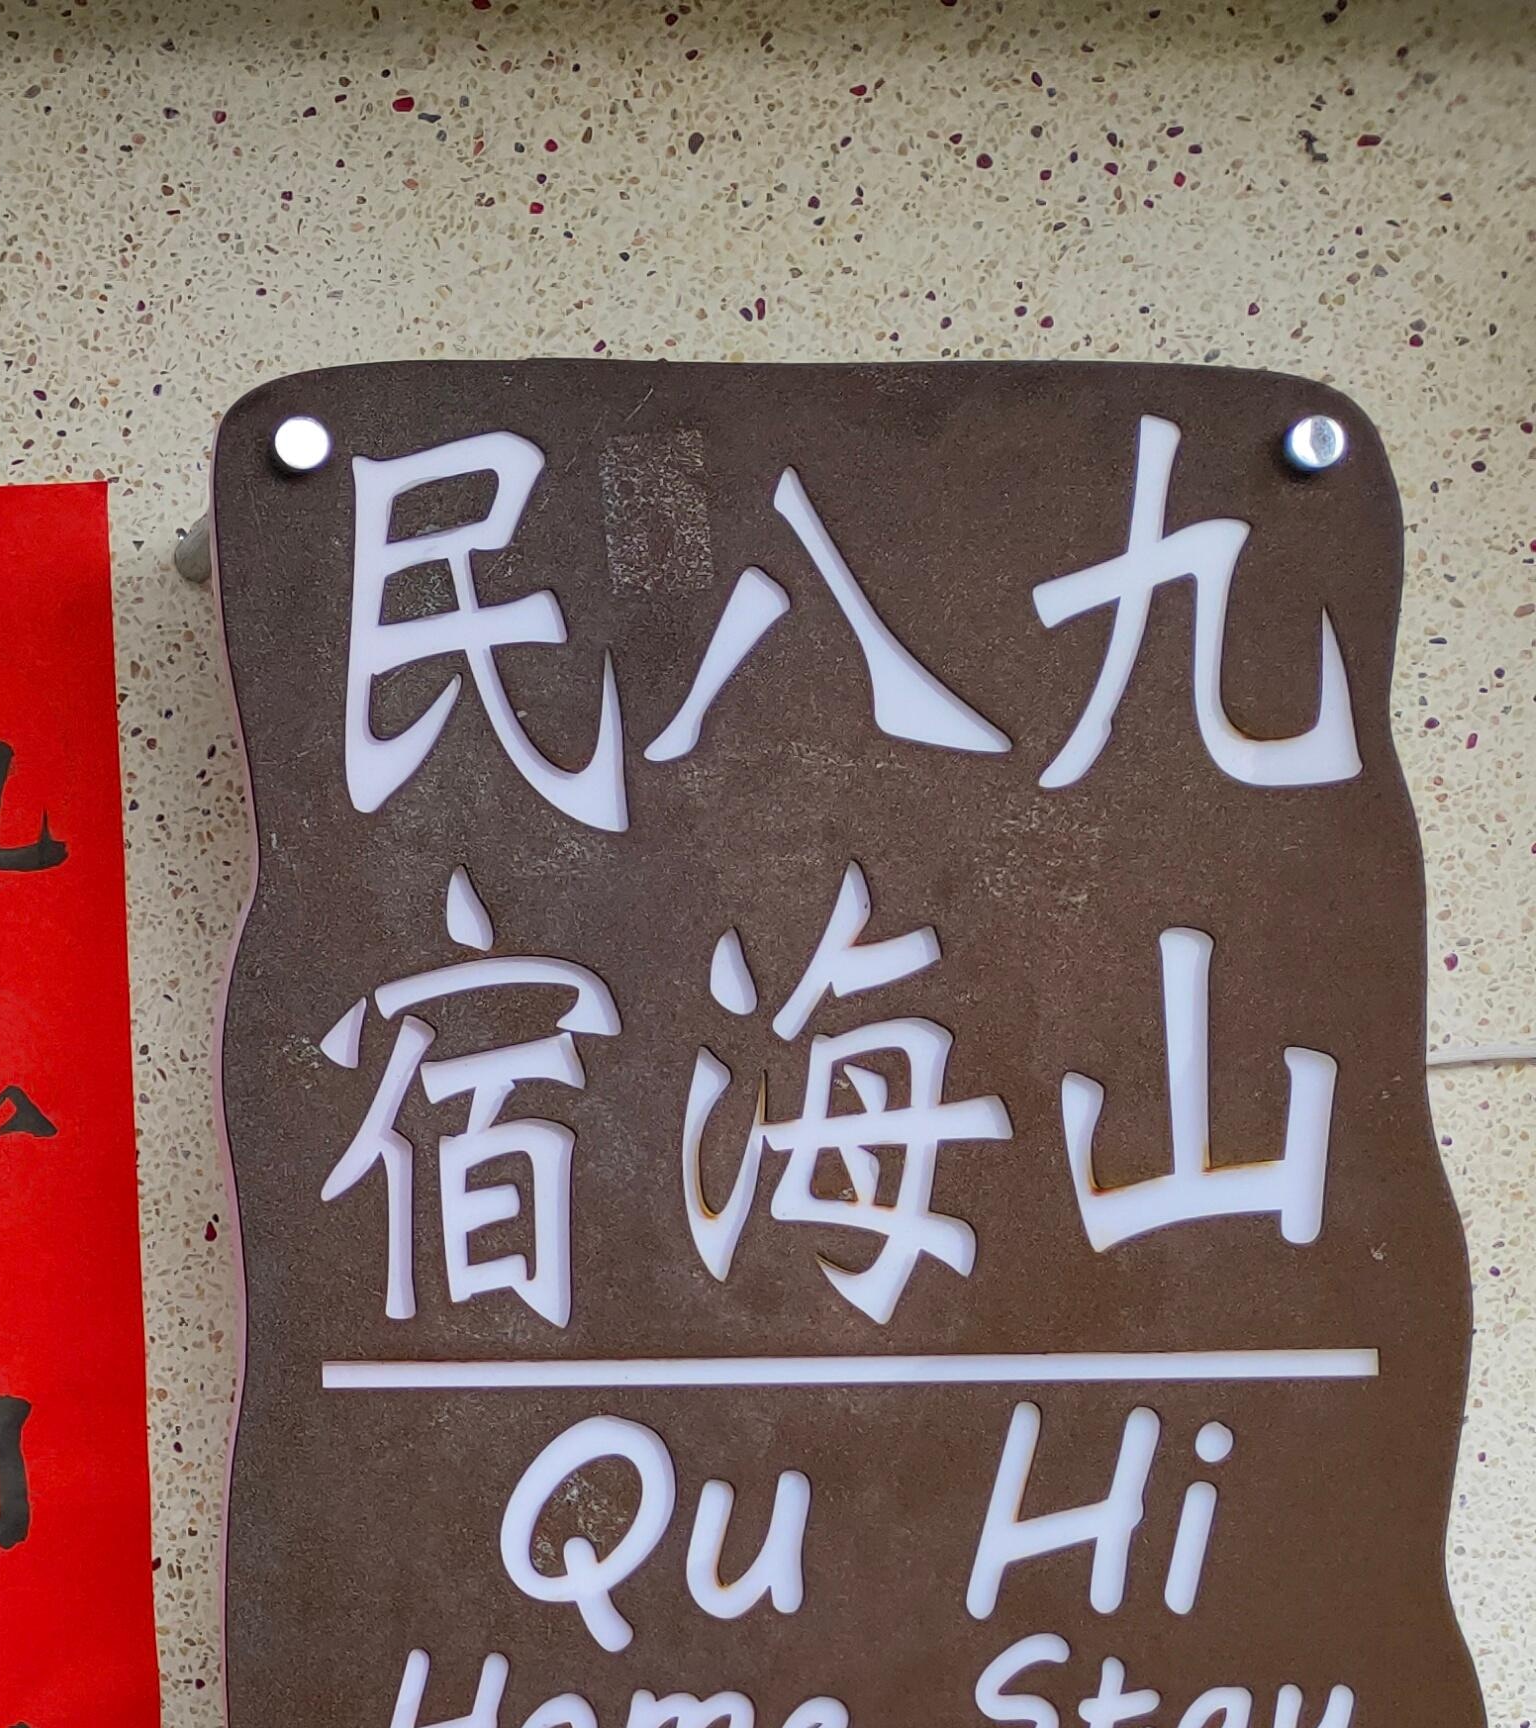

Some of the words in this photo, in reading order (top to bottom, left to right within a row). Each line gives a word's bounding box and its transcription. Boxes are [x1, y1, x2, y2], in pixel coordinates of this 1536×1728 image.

[321, 430, 629, 1327] 民宿
[643, 466, 1013, 1324] 八海
[1033, 415, 1363, 1252] 九山
[499, 1414, 812, 1652] Qu
[965, 1402, 1234, 1619] Hi
